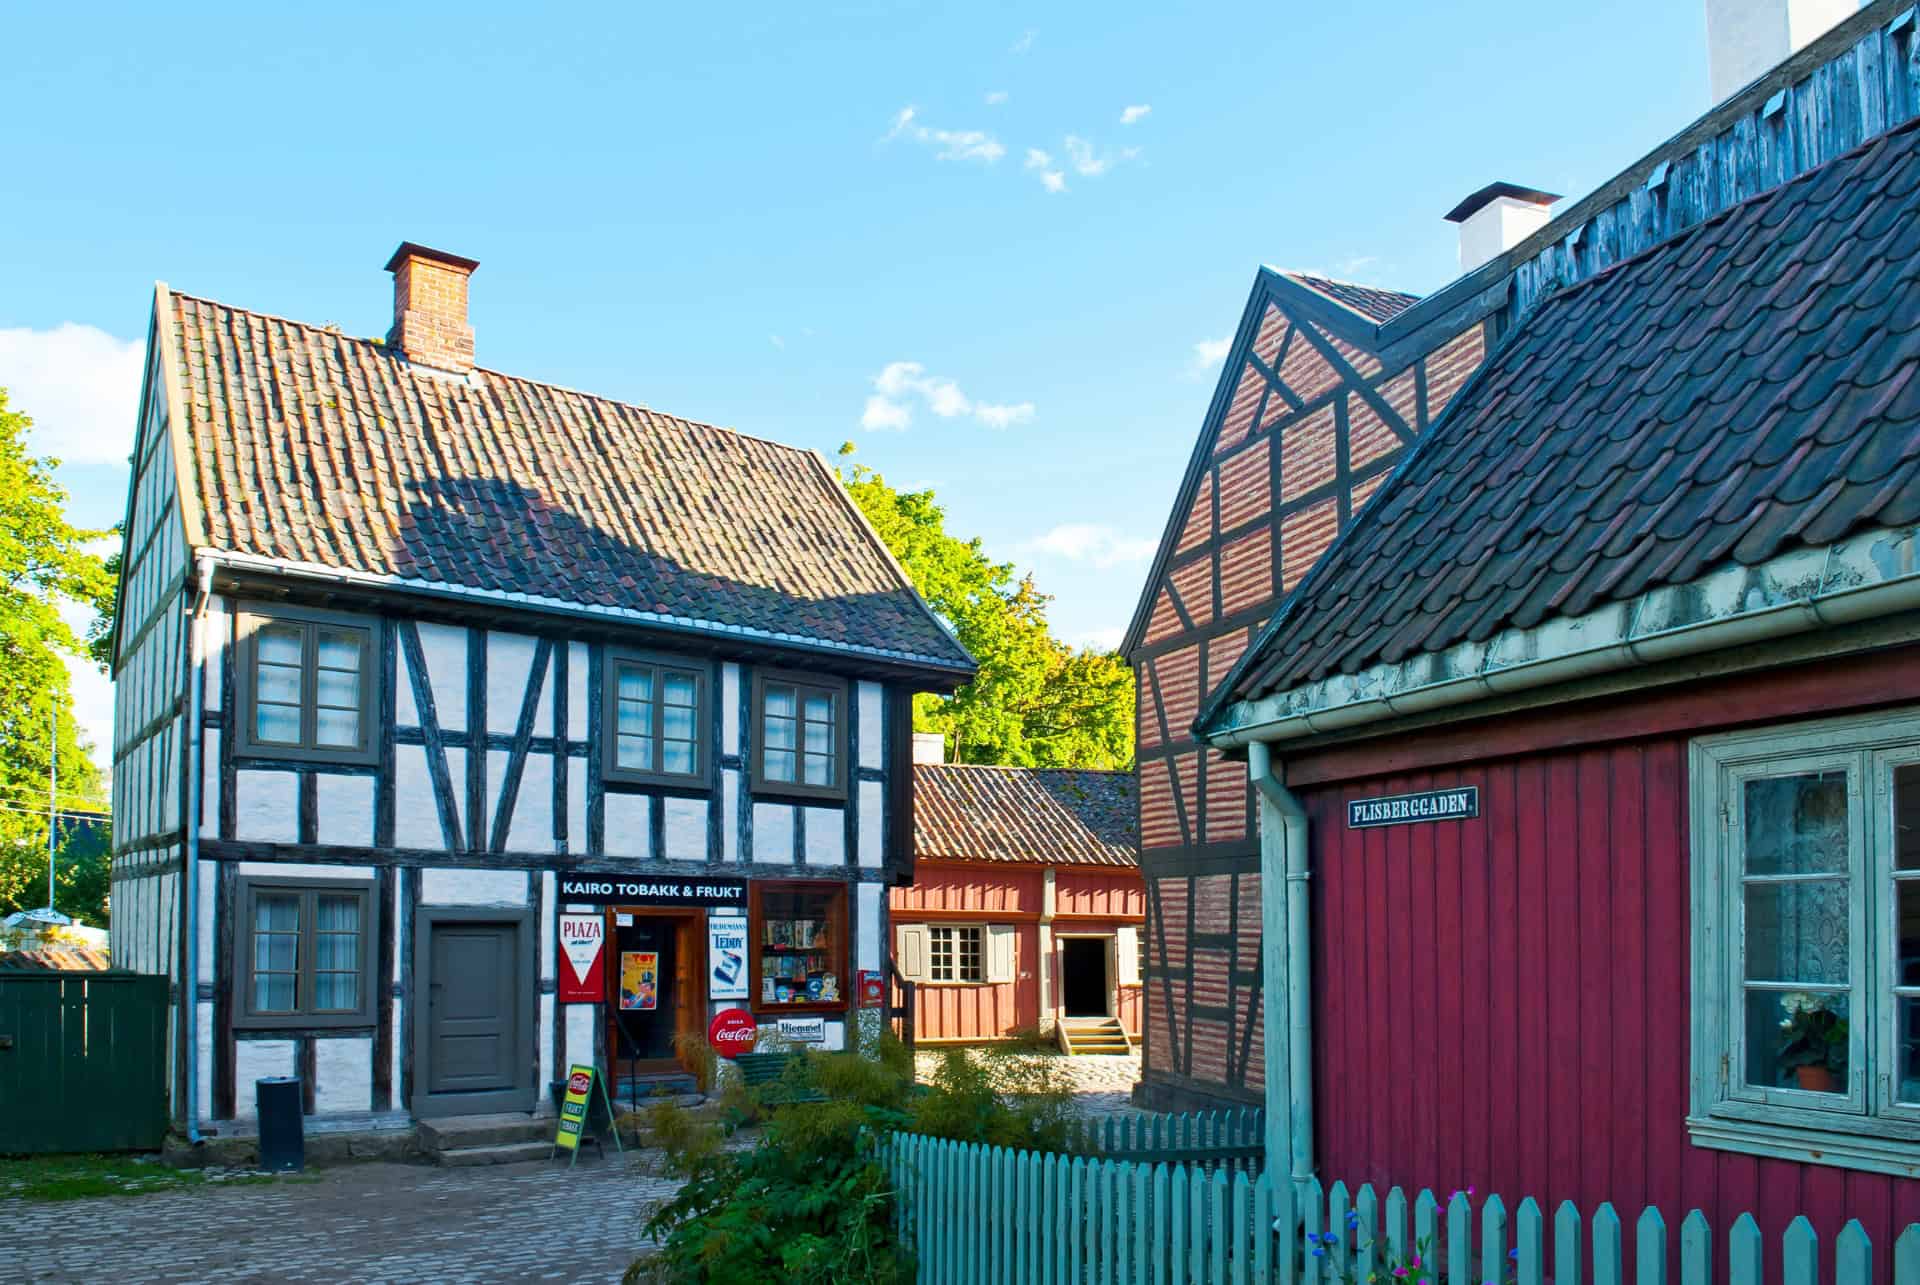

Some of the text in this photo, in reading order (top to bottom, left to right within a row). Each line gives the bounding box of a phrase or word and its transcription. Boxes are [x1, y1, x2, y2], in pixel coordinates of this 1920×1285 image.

[562, 881, 743, 898] KAIRO TOBAKK & FRUKT
[563, 921, 601, 938] PLAZA
